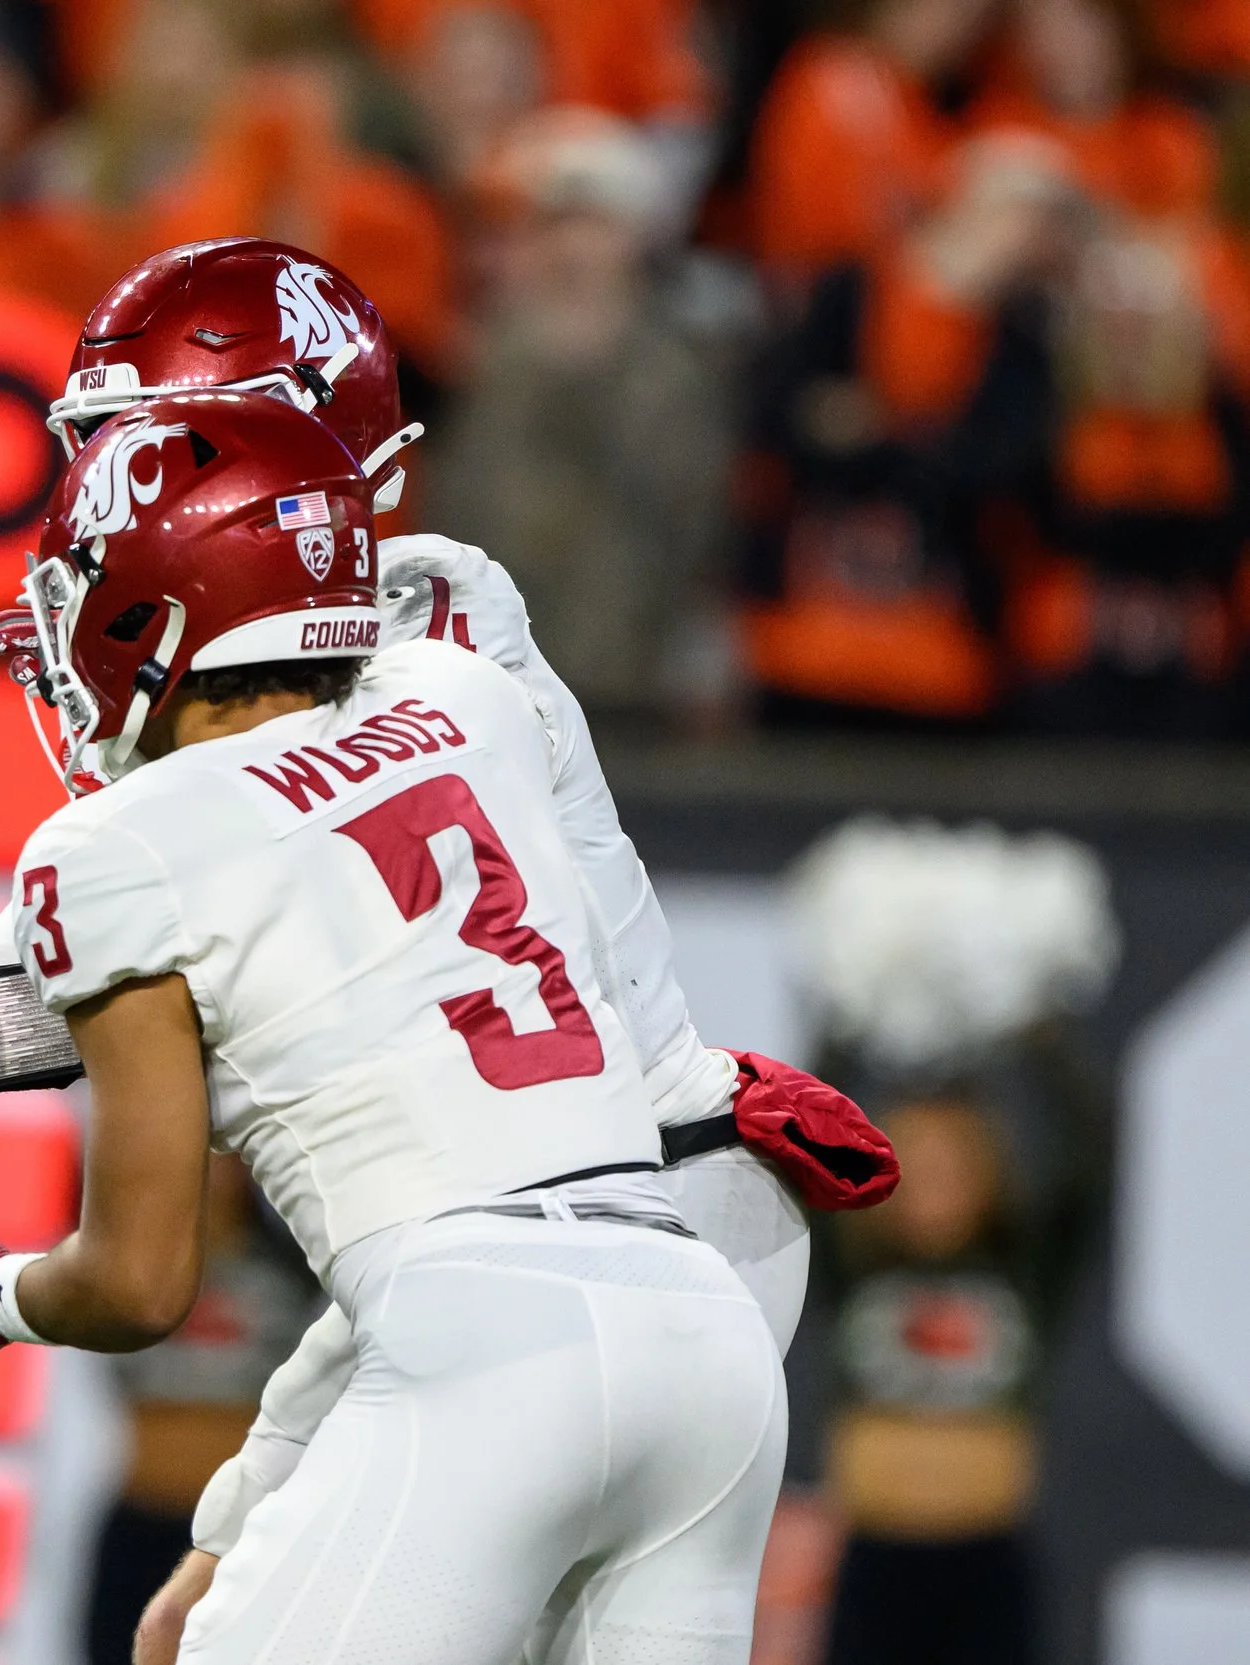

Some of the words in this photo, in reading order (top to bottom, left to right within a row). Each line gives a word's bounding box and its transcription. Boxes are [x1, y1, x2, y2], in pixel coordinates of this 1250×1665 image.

[79, 368, 107, 392] WSU
[309, 549, 329, 570] 12
[353, 527, 370, 579] 3
[300, 619, 381, 650] COUGARS
[241, 698, 467, 814] WOODS
[22, 864, 74, 979] 3
[330, 772, 605, 1091] 3
